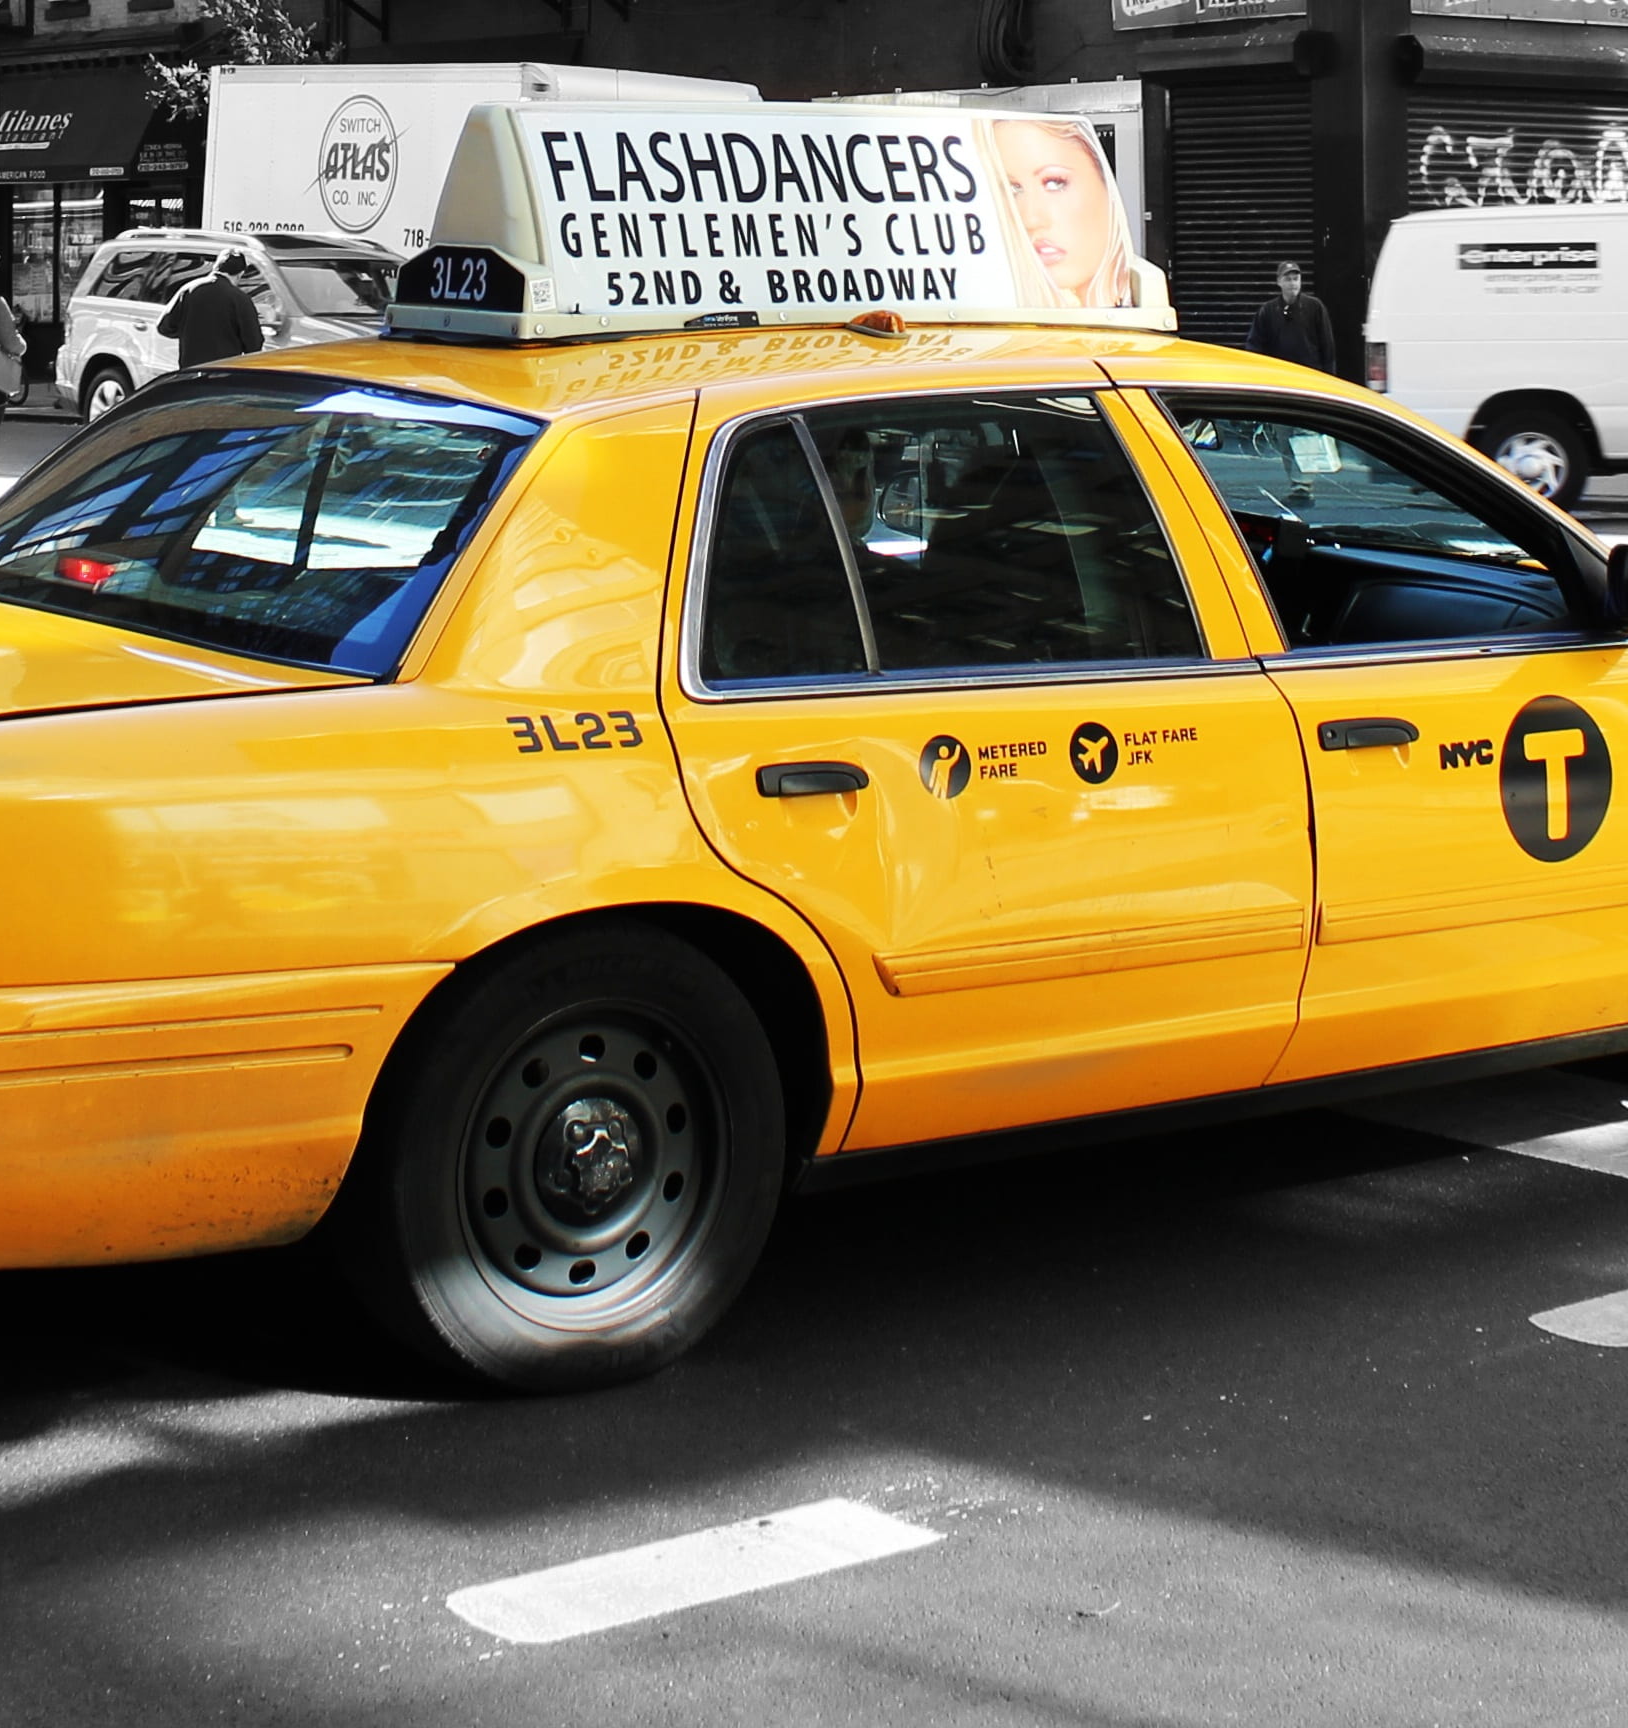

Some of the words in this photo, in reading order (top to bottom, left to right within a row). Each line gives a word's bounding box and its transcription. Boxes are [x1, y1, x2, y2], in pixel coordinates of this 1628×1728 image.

[338, 117, 382, 134] SWITCH
[323, 137, 392, 184] ATLAS
[539, 129, 978, 205] FLASHDANCERS
[28, 169, 46, 180] FOOD
[332, 189, 352, 206] CO.
[357, 190, 379, 207] INC.
[559, 211, 862, 259] GENTLEMEN'S
[885, 212, 987, 257] CLUB
[1462, 245, 1599, 267] enterprise
[429, 256, 488, 303] 3L23
[606, 269, 703, 307] 52ND
[718, 269, 744, 306] &
[766, 266, 960, 305] BROADWAY
[505, 709, 644, 754] 3L23
[1123, 728, 1159, 747] FLAT
[1160, 726, 1199, 744] FARE
[976, 739, 1048, 762] METERED
[1125, 748, 1154, 767] JFK
[978, 761, 1019, 781] FARE
[1438, 738, 1494, 771] NYC
[1522, 727, 1587, 842] T
